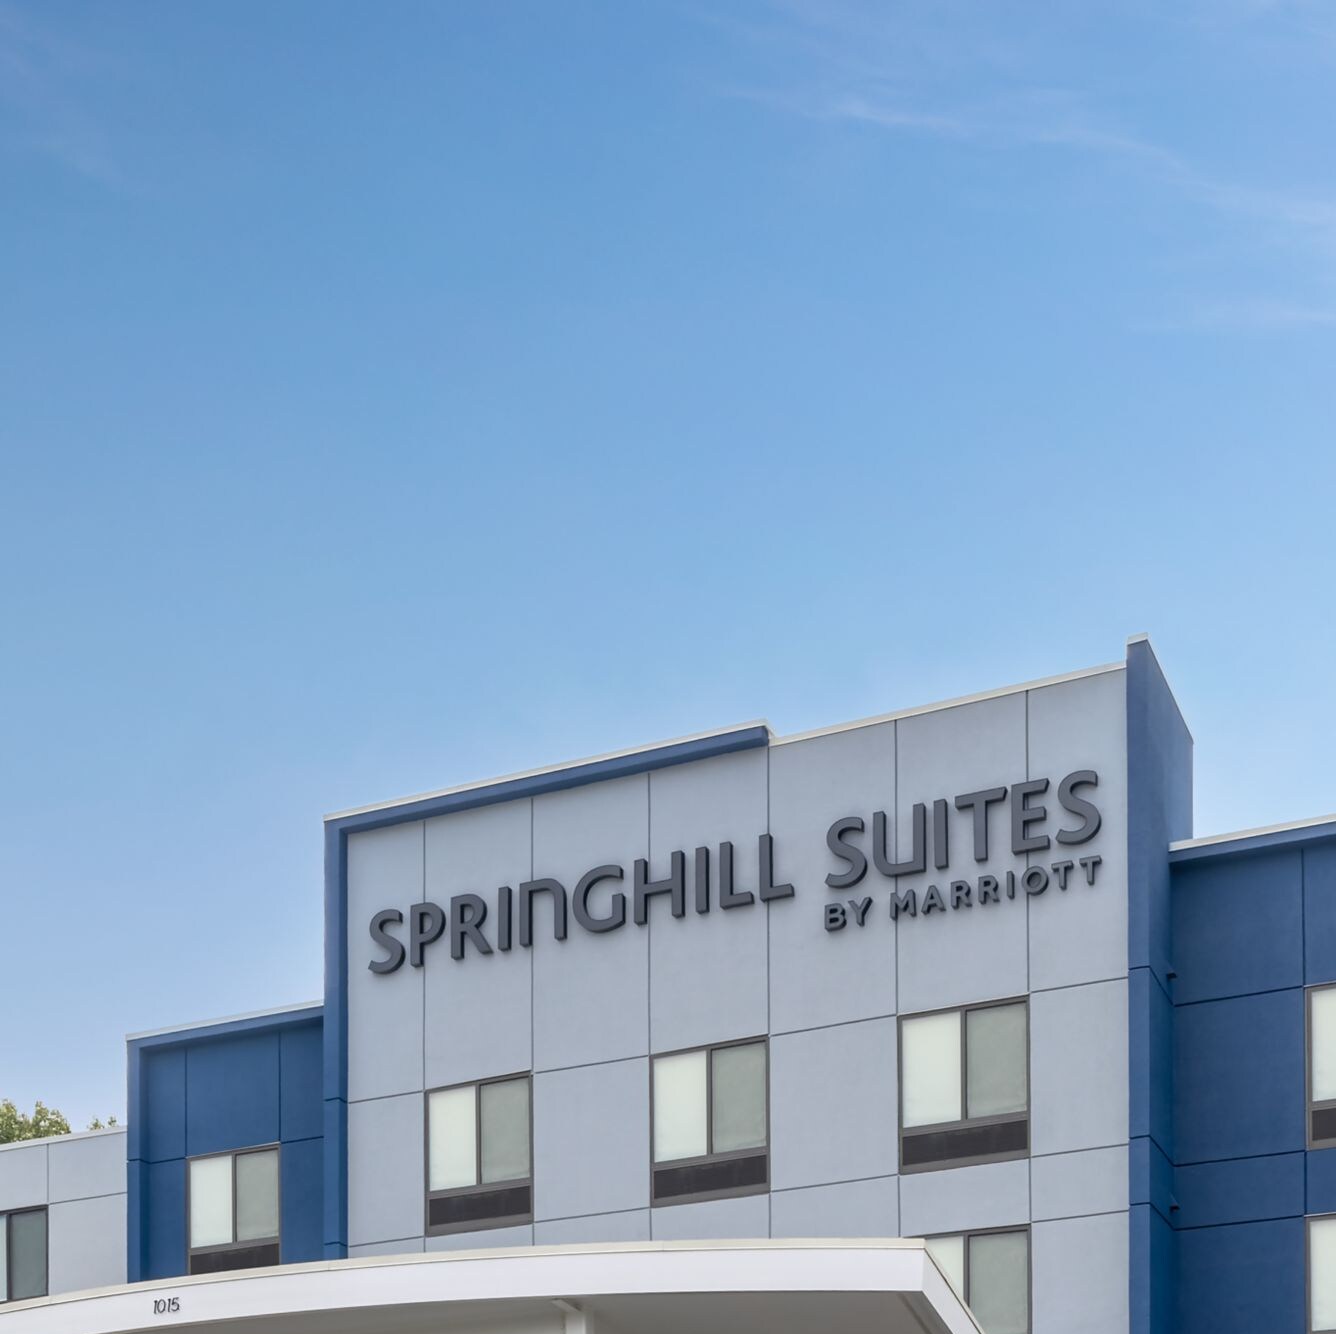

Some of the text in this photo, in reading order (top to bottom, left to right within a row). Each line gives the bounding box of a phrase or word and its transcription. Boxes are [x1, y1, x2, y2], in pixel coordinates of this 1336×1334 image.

[368, 770, 1102, 975] SPRINGHILL SUITES
[824, 855, 1102, 932] BY MARRIOTT
[153, 1297, 180, 1314] 1015
